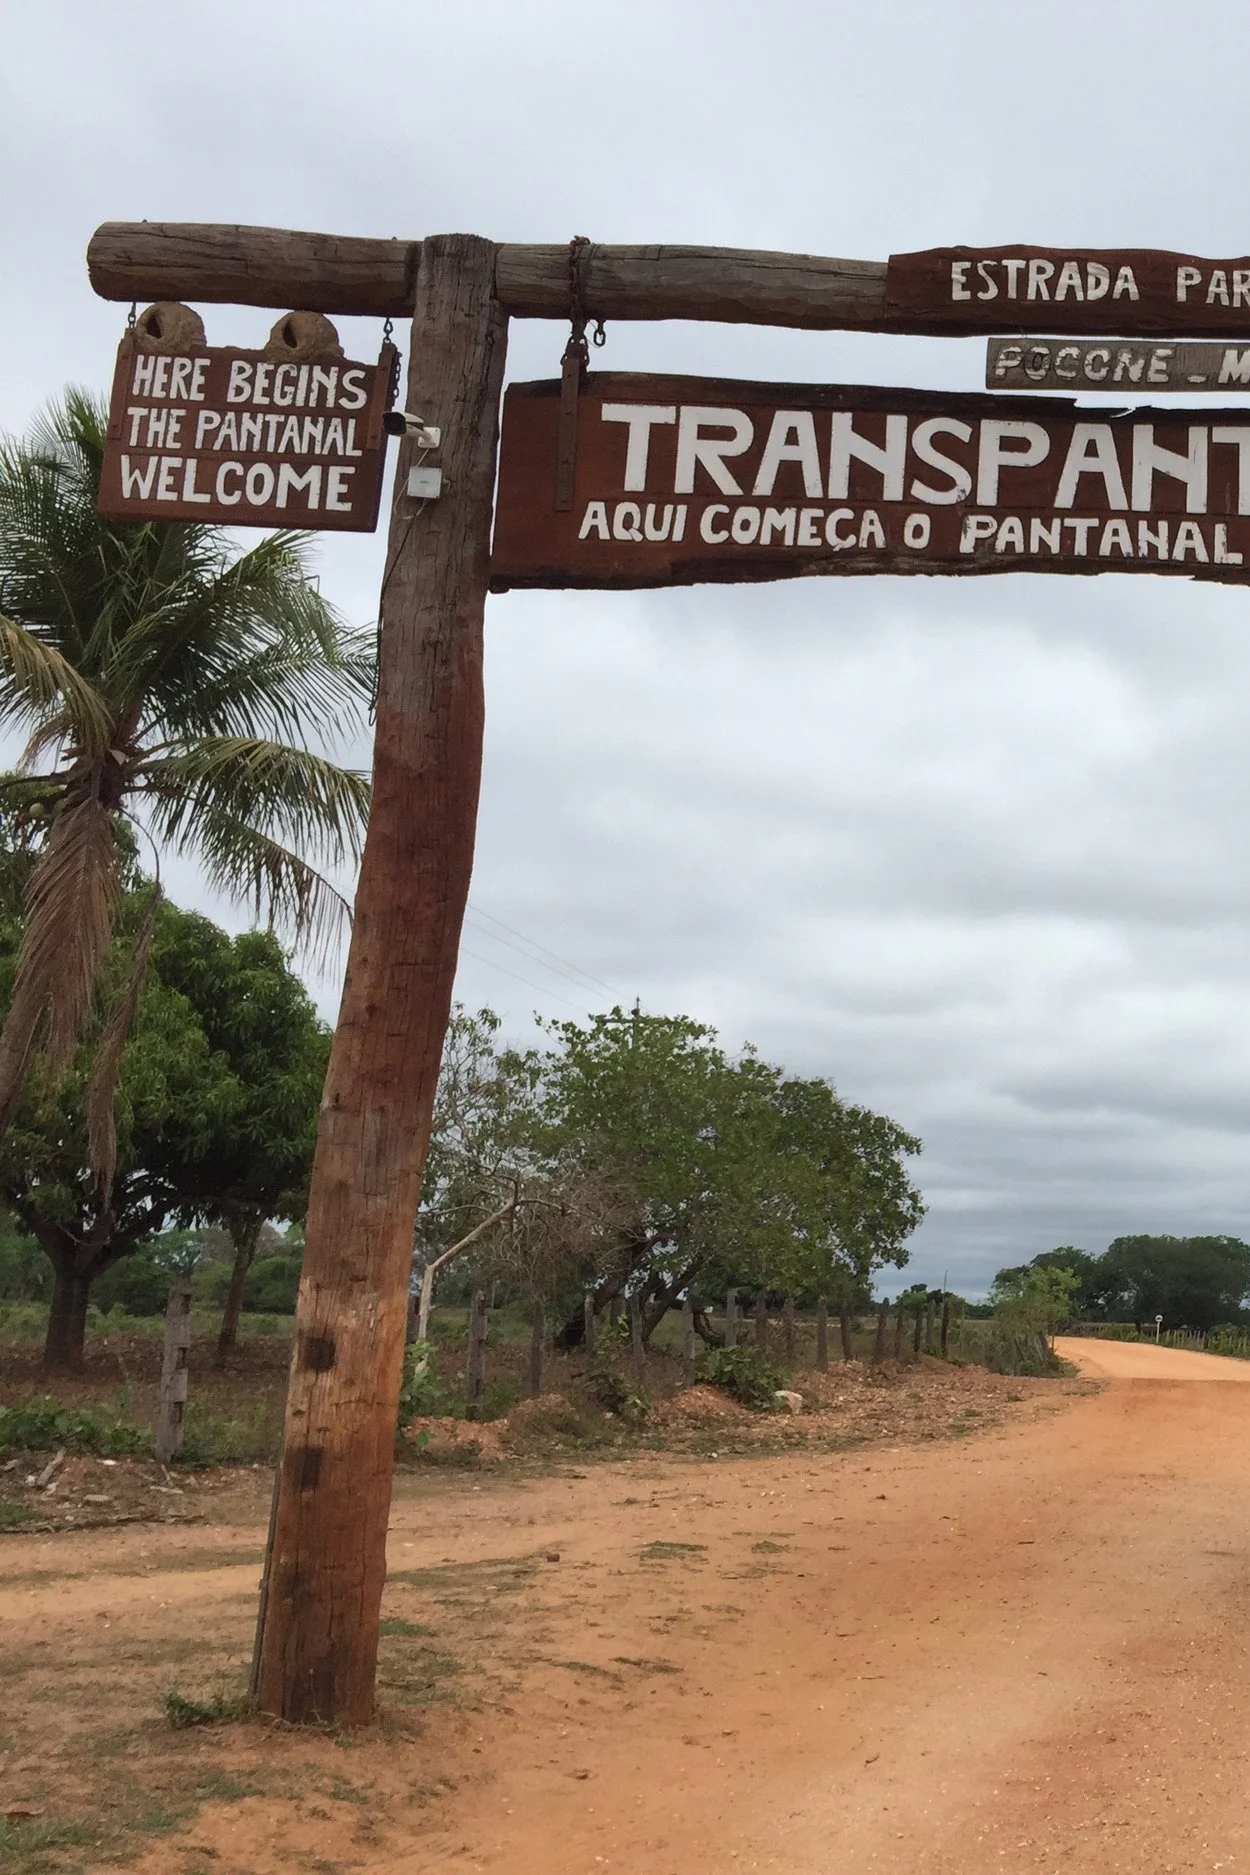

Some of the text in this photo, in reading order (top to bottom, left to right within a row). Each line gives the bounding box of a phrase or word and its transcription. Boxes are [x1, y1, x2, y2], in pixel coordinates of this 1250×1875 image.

[951, 259, 1139, 301] ESTRADA
[131, 354, 368, 410] HERE BEGINS
[127, 406, 363, 457] THE PANTANAL
[120, 454, 356, 512] WELCOME
[578, 501, 687, 542] AQUI
[699, 504, 886, 552] COMEÇA
[904, 513, 931, 549] O
[959, 515, 1243, 565] PANTANAL
